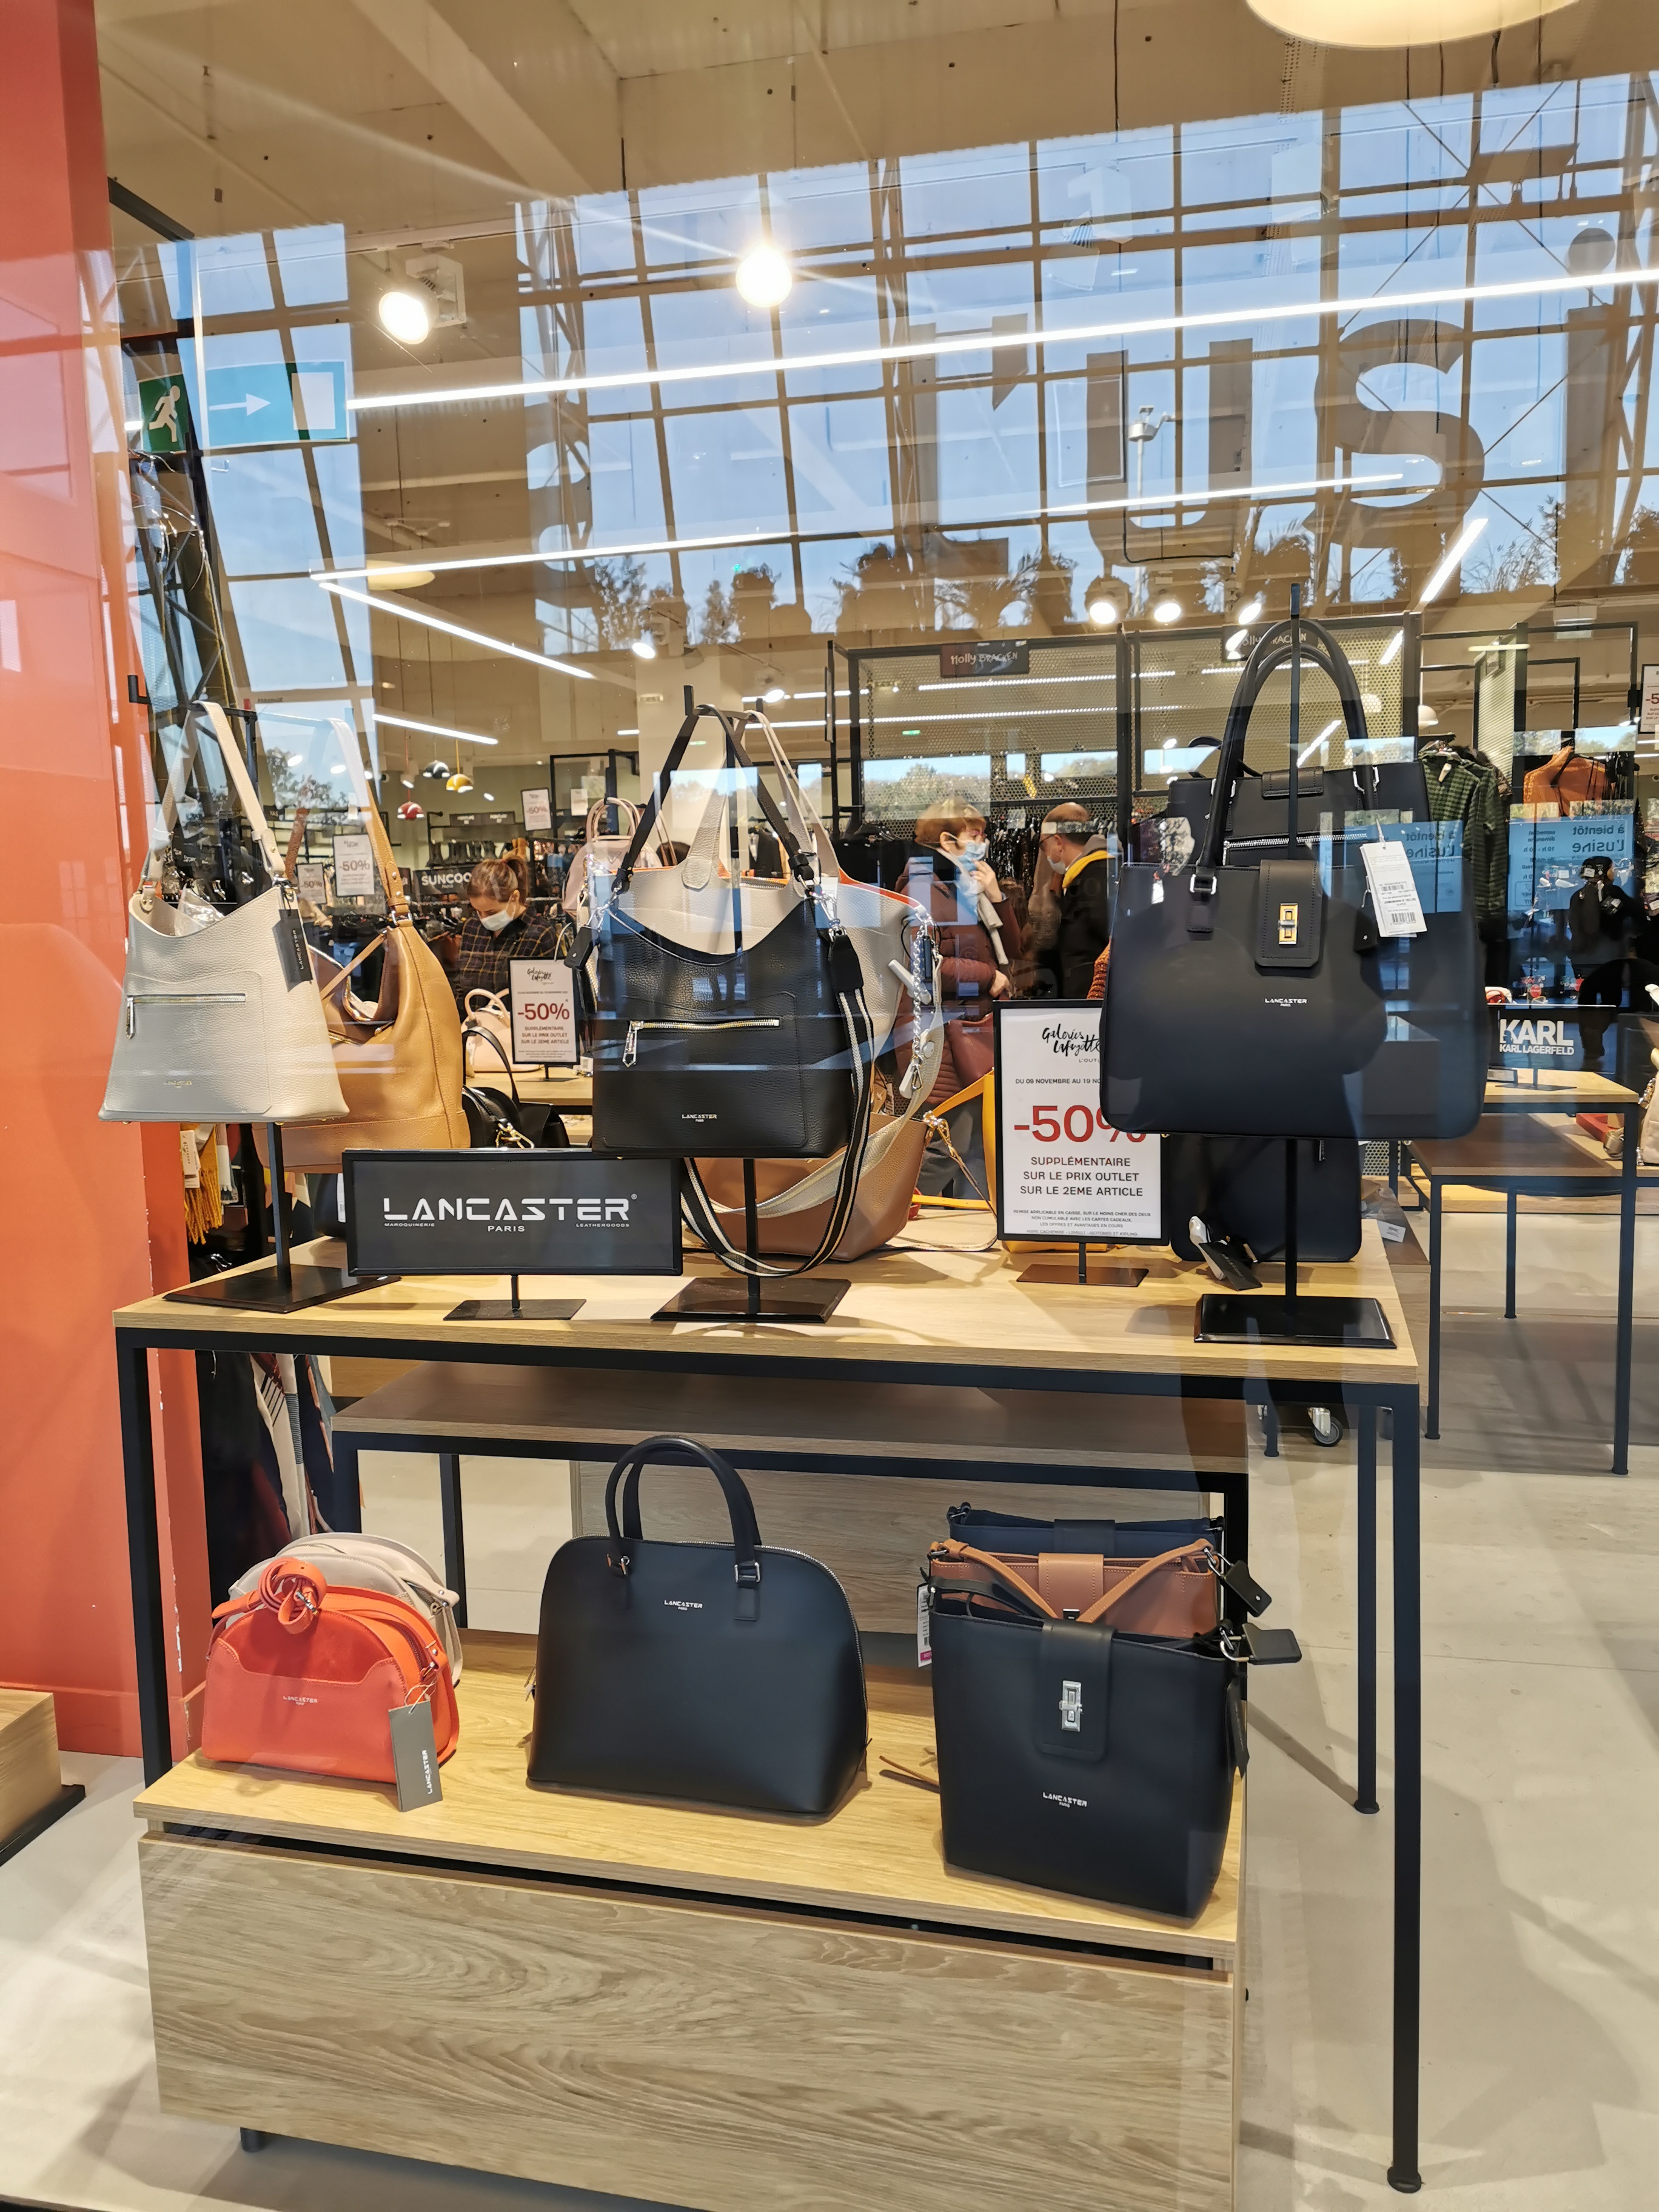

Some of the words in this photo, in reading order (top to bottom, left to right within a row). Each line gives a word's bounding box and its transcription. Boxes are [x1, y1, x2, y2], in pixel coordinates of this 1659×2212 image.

[951, 653, 976, 665] Holly
[979, 651, 1018, 663] BRACKEN
[339, 860, 370, 871] -50%
[292, 930, 304, 970] LANCASTER
[1042, 1024, 1084, 1043] Galeries
[1500, 1019, 1574, 1047] KARL
[1500, 1044, 1522, 1053] KARL
[1523, 1045, 1574, 1056] LAGERFELD
[1031, 1156, 1131, 1167] SUPPLÉMENTAIRE
[1023, 1171, 1045, 1180] SUR
[1066, 1172, 1091, 1181] PRIX
[1095, 1172, 1139, 1181] OUTLET
[1020, 1186, 1042, 1195] SUR
[1063, 1187, 1092, 1195] 2EME
[1096, 1187, 1143, 1196] ARTICLE
[664, 1600, 703, 1608] LANCASTER
[422, 1750, 433, 1794] LANCASTER
[1043, 1792, 1087, 1807] LANCASTER
